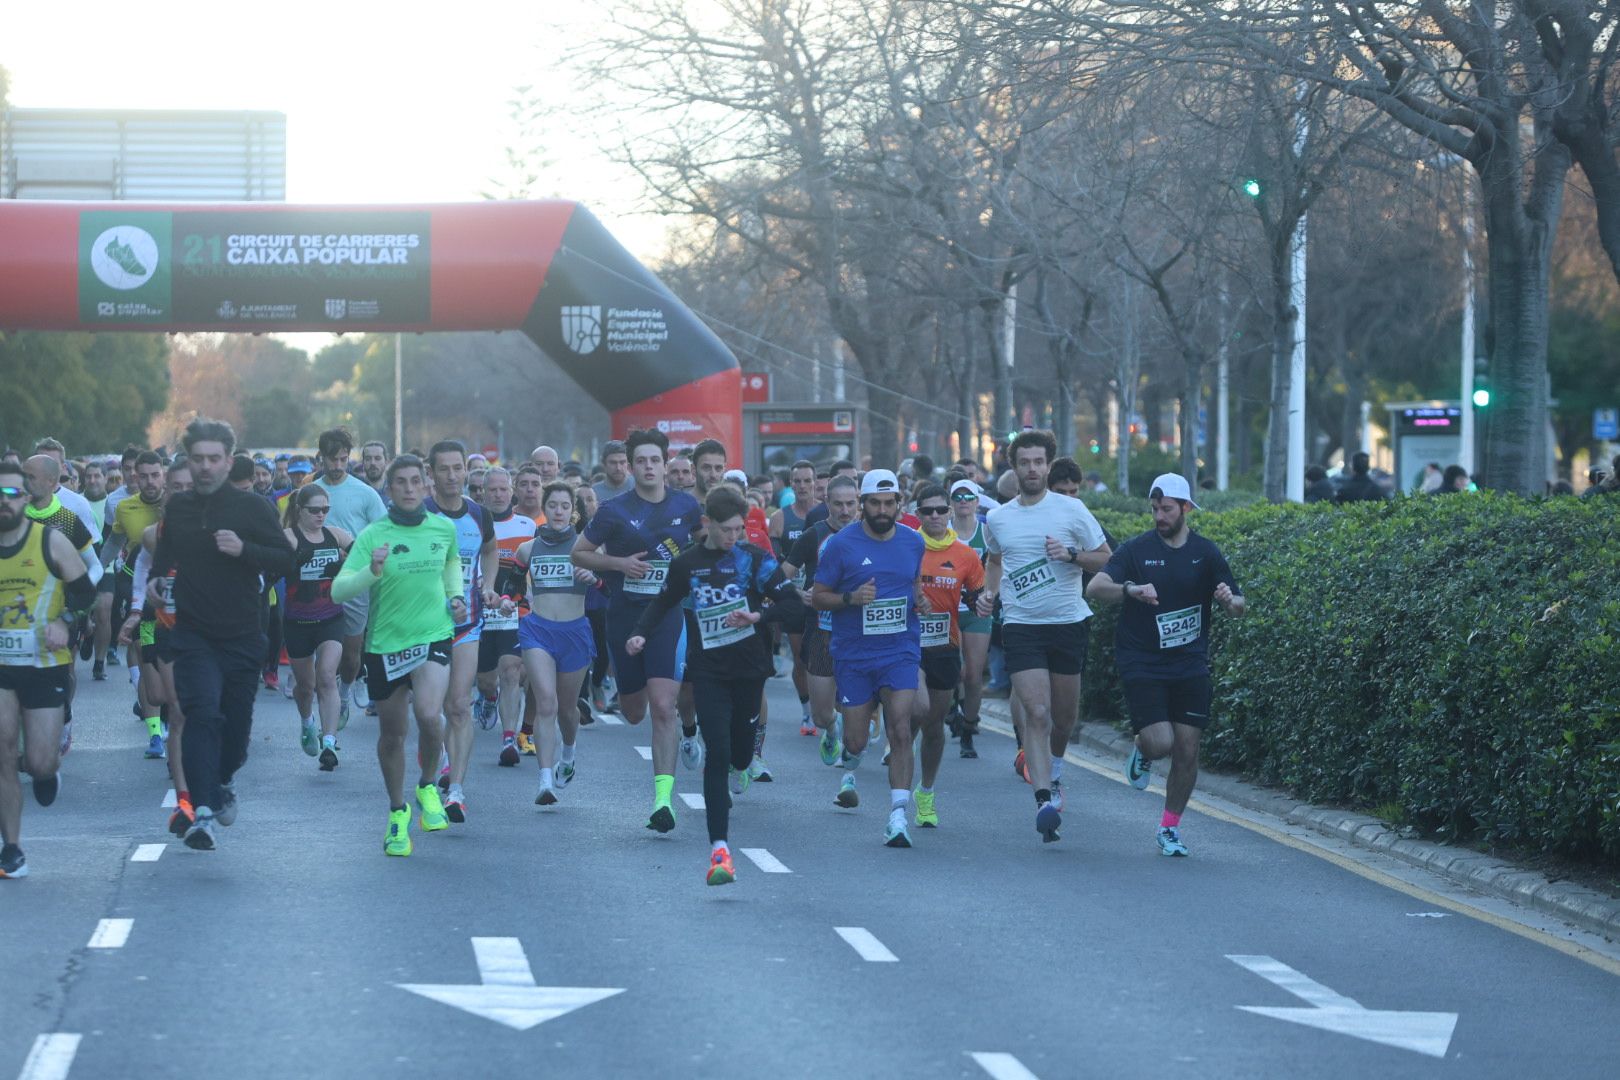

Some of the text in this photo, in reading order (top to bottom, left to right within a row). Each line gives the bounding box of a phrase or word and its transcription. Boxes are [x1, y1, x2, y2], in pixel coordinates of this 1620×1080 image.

[226, 234, 420, 249] CIRCUIT DE CARRERES
[183, 234, 221, 265] 21
[226, 247, 409, 265] CAIXA POPULAR
[607, 330, 669, 343] Municipal
[533, 564, 566, 576] 7972
[640, 569, 665, 580] 78
[935, 575, 957, 585] STOP
[1013, 568, 1046, 592] 5241
[866, 608, 903, 622] 5239
[702, 616, 730, 633] 772
[1161, 616, 1197, 636] 5242
